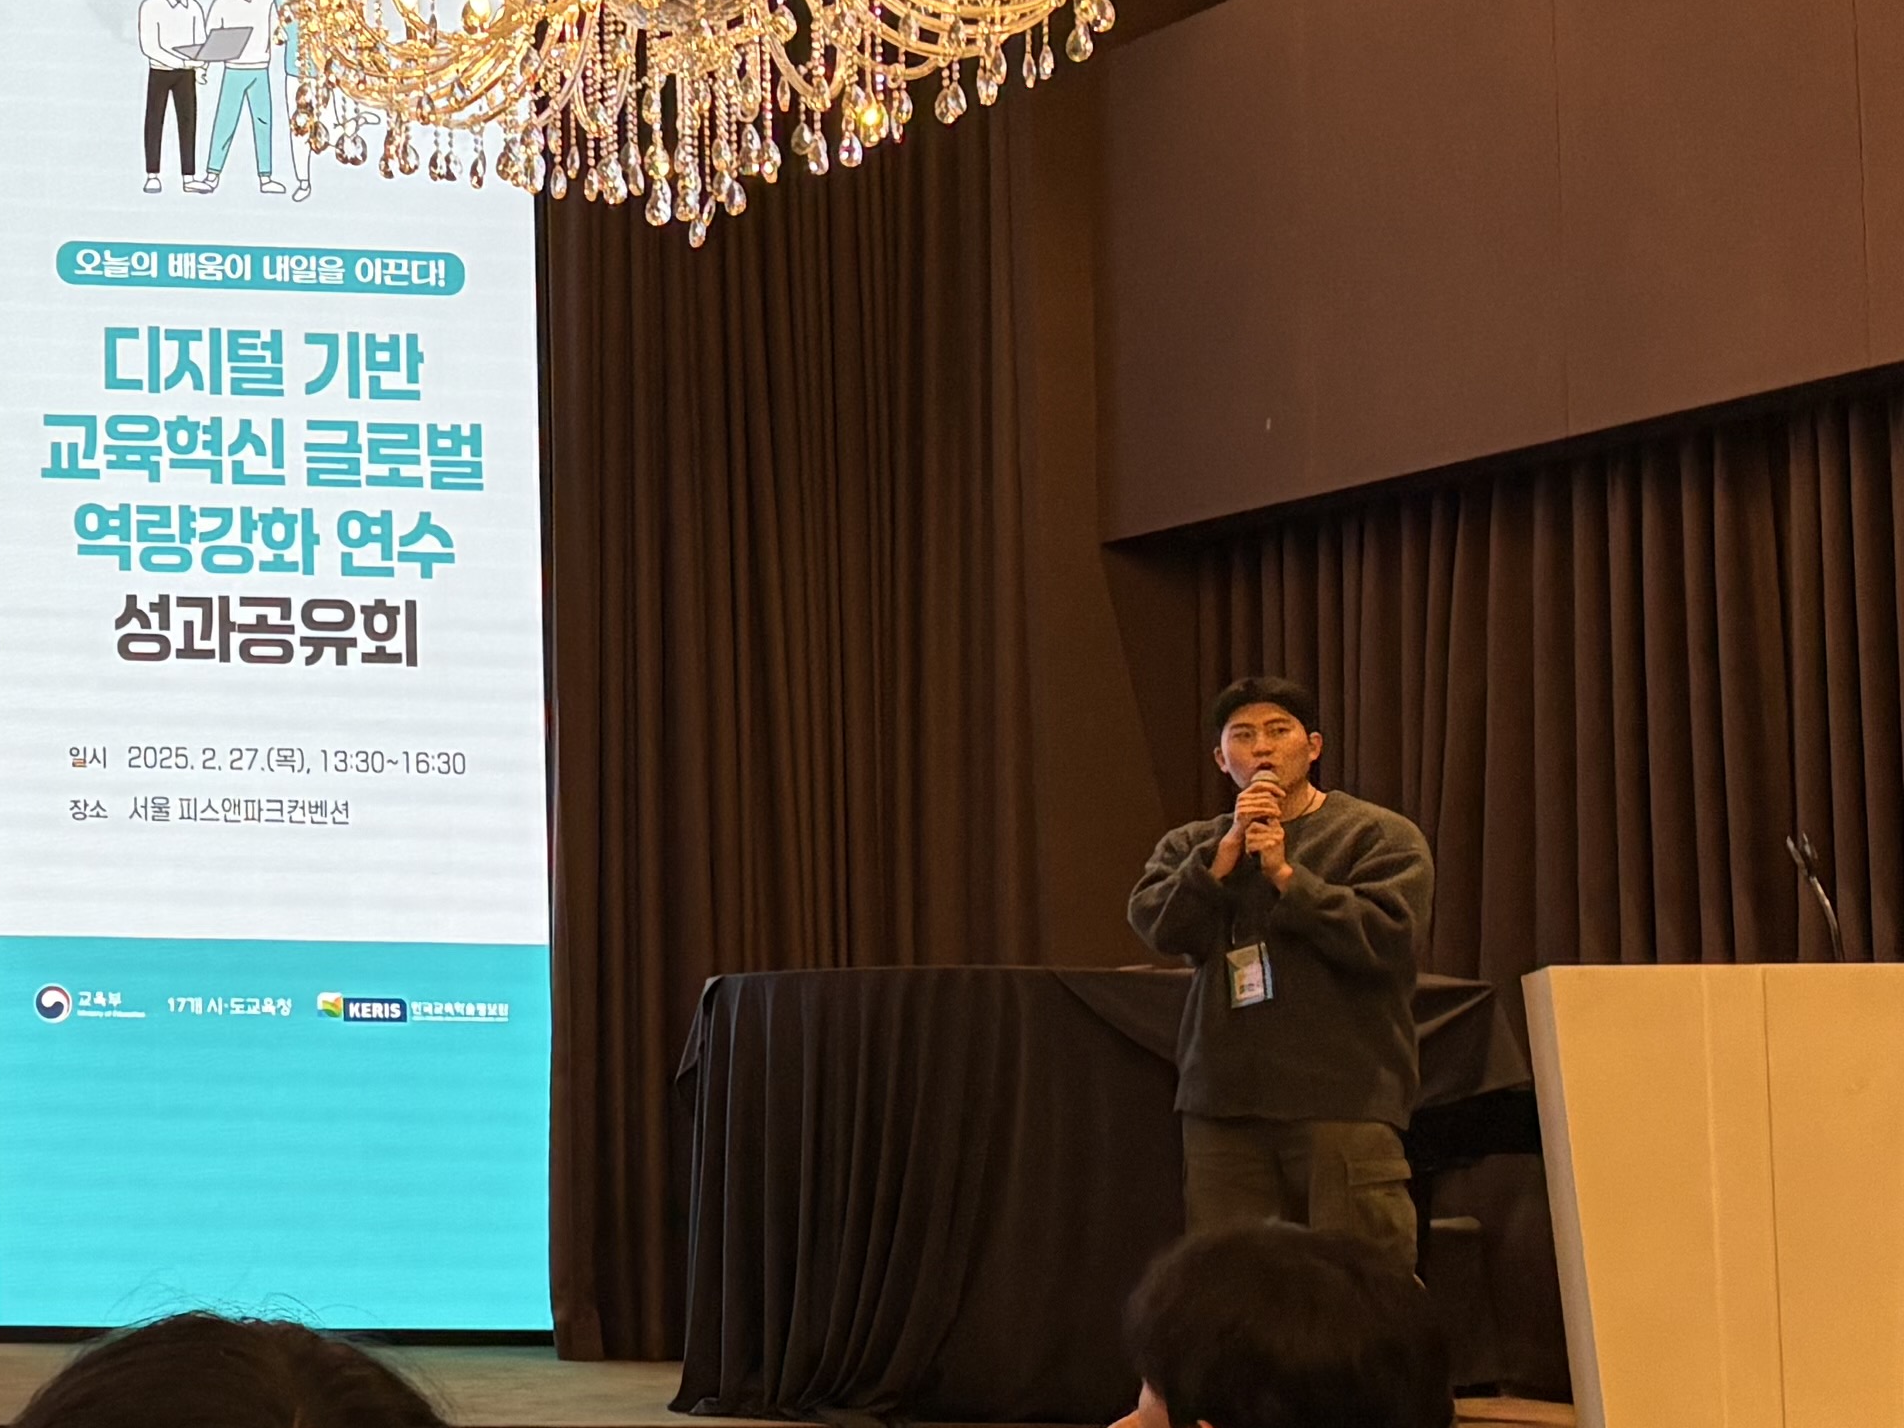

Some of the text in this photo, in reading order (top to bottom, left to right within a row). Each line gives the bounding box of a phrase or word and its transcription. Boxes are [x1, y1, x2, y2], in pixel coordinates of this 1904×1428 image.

[75, 249, 445, 287] 오늘의 배움이 내일을 이끈다!
[104, 326, 424, 401] 디지털 기반
[41, 414, 484, 491] 교육혁신 글로벌
[74, 503, 455, 579] 역량강화 연수
[115, 594, 417, 667] 성과공유회
[70, 747, 106, 768] 일시
[128, 746, 193, 769] 2025.
[202, 748, 221, 770] 2.
[321, 750, 465, 774] 13:30~16:30
[70, 797, 349, 824] 장소 서울 피스앤파크컨벤션
[349, 1003, 401, 1018] KERIS
